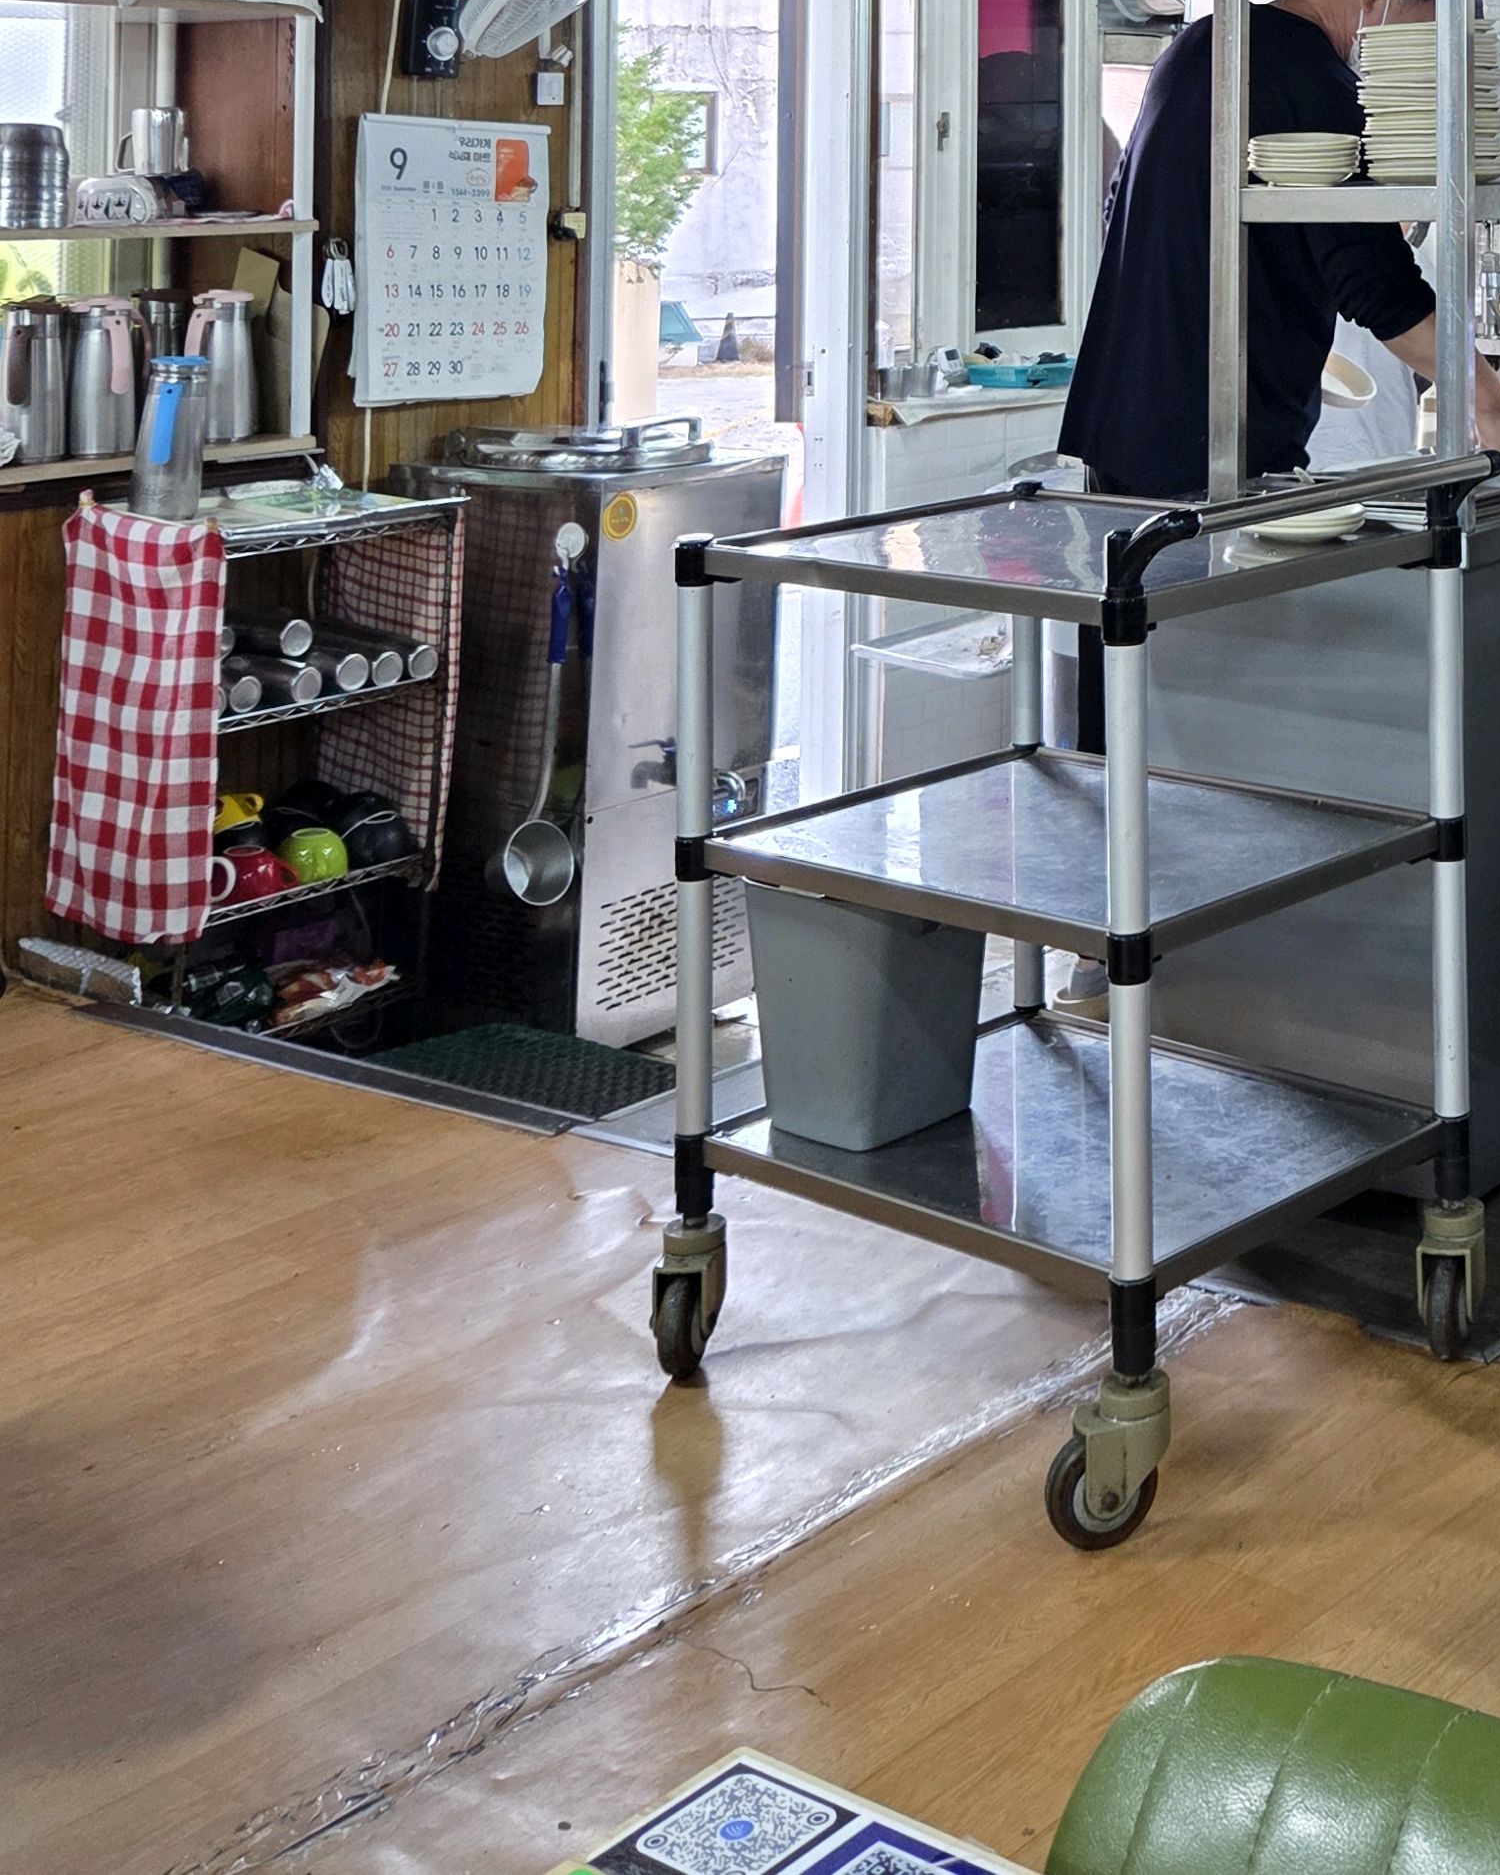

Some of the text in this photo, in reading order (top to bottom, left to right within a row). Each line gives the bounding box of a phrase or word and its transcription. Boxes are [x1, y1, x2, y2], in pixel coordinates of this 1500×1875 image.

[390, 147, 408, 180] 9
[432, 208, 527, 224] 1 2 3 4 5
[386, 245, 531, 261] 6 7 8 9 10 11 12
[385, 284, 531, 298] 13 14 15 16 17 18 19
[385, 321, 529, 337] 20 21 22 23 24 25 26
[384, 360, 463, 377] 27 28 29 30
